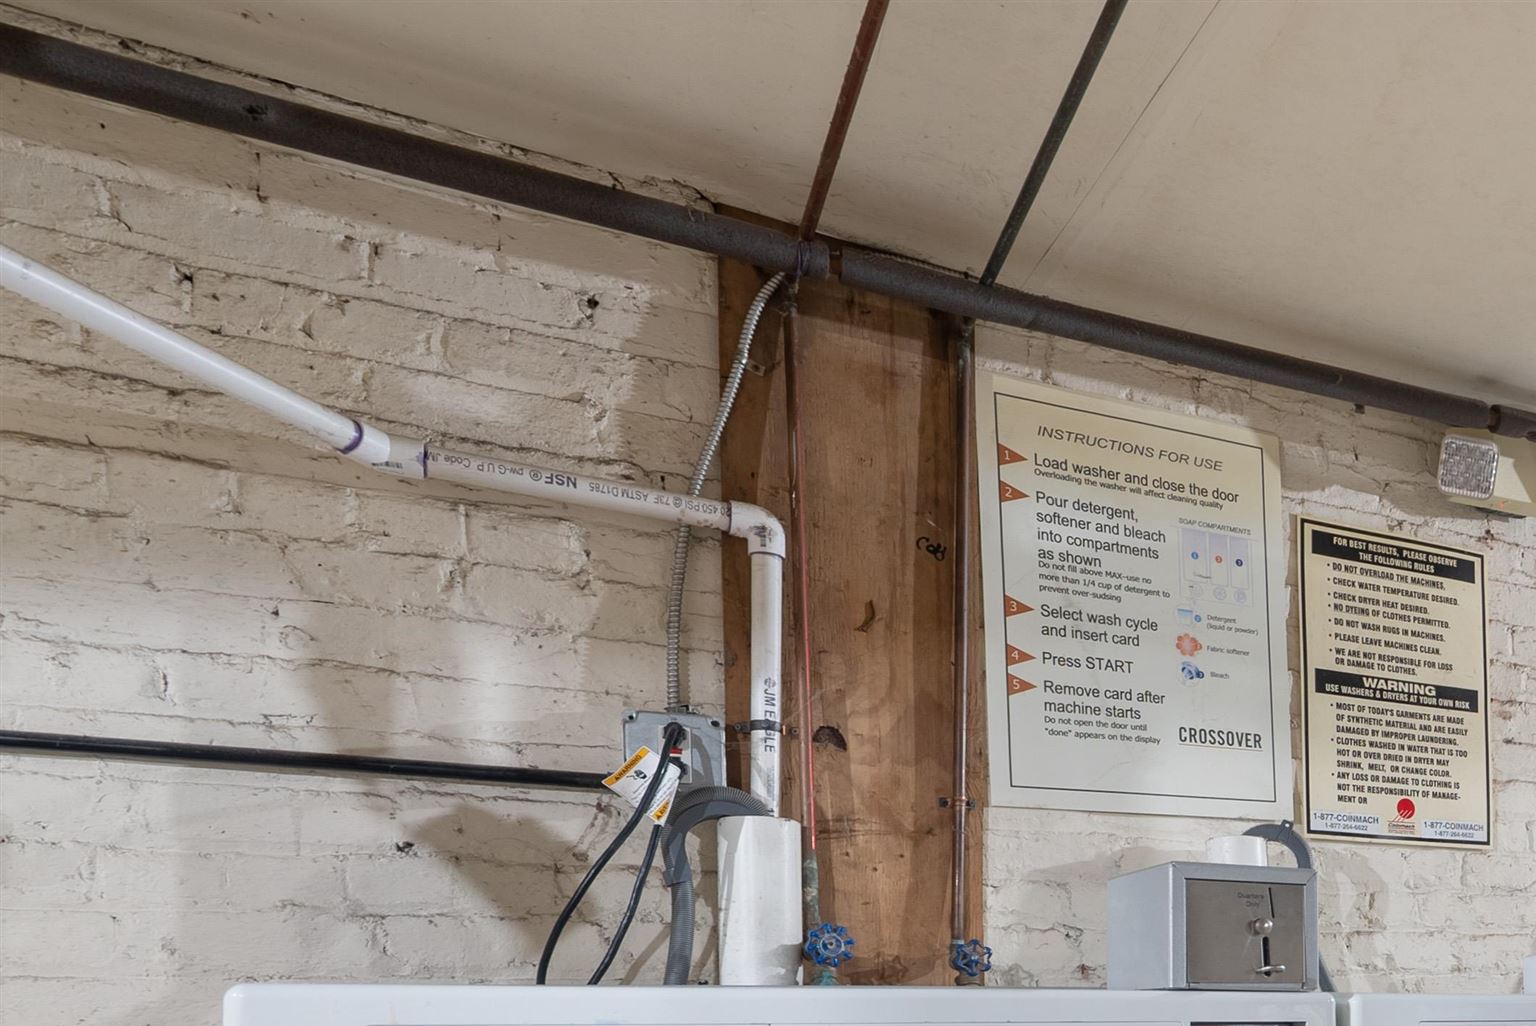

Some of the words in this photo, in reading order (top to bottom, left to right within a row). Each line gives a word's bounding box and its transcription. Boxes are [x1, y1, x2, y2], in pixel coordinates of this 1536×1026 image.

[1004, 449, 1011, 461] 1
[1037, 425, 1155, 458] INSTRUCTIONS
[1158, 449, 1190, 465] FOR
[1193, 456, 1223, 472] USE
[443, 454, 471, 468] Code
[545, 473, 577, 489] NSF
[1034, 452, 1068, 472] Load
[1071, 463, 1121, 481] washer
[1123, 473, 1148, 487] and
[1151, 476, 1185, 493] close
[1188, 482, 1208, 498] the
[1211, 487, 1239, 503] door
[589, 481, 620, 498] D1785
[621, 487, 648, 501] ASTM
[1004, 486, 1013, 498] 2
[684, 500, 700, 511] PSI
[1035, 490, 1069, 508] Pour
[1071, 497, 1138, 523] detergent,
[1035, 511, 1092, 530] softener
[1095, 522, 1119, 535] and
[1123, 523, 1166, 543] bleach
[1037, 527, 1062, 544] into
[1066, 535, 1159, 560] compartments
[1332, 536, 1348, 547] FOR
[1348, 539, 1367, 550] BEST
[1367, 542, 1399, 557] RESULTS,
[1402, 549, 1427, 562] PLEASE
[1428, 554, 1457, 568] OBSERVE
[1037, 548, 1054, 561] as
[1058, 550, 1102, 568] shown
[1358, 551, 1372, 562] THE
[1373, 554, 1412, 569] FOLLOWING
[1413, 561, 1435, 573] RULES
[1332, 561, 1342, 572] DO
[1343, 564, 1358, 575] NOT
[1359, 567, 1394, 581] OVERLOAD
[1395, 573, 1409, 584] THE
[1332, 576, 1356, 588] CHECK
[1357, 580, 1381, 592] WATER
[1382, 585, 1429, 601] TEMPERATURE
[1009, 600, 1017, 612] 3
[1332, 591, 1357, 603] CHECK
[1357, 595, 1380, 607] DRYER
[1381, 599, 1399, 609] HEAT
[1040, 603, 1084, 622] Select
[1086, 612, 1122, 627] wash
[1125, 617, 1158, 632] cycle
[1333, 602, 1344, 612] NO
[1344, 604, 1370, 617] DYEING
[1371, 608, 1380, 617] OF
[1382, 610, 1411, 623] CLOTHES
[1040, 624, 1067, 638] and
[1070, 625, 1109, 643] insert
[1111, 634, 1140, 647] card
[1333, 617, 1344, 626] DO
[1345, 619, 1359, 629] NOT
[1360, 621, 1381, 632] WASH
[1382, 624, 1400, 635] RUGS
[1401, 628, 1409, 636] IN
[1334, 632, 1360, 644] PLEASE
[1361, 636, 1382, 647] LEAVE
[1383, 639, 1418, 652] MACHINES
[1011, 650, 1019, 661] 4
[1042, 651, 1082, 668] Press
[1085, 655, 1134, 674] START
[1012, 678, 1020, 690] 5
[1043, 679, 1100, 698] Remove
[1103, 688, 1132, 701] card
[1136, 689, 1166, 704] after
[1362, 676, 1436, 696] WARNING
[764, 689, 776, 707] JM
[1325, 683, 1339, 693] USE
[1340, 685, 1374, 698] WASHERS
[1375, 689, 1381, 698] &
[1382, 690, 1409, 702] DRYERS
[1409, 694, 1418, 703] AT
[1418, 695, 1437, 706] YOUR
[1437, 697, 1454, 708] OWN
[1454, 699, 1470, 710] RISK
[1043, 701, 1101, 716] machine
[1105, 705, 1141, 720] starts
[764, 709, 776, 753] EGLE
[1178, 726, 1262, 749] CROSSOVER
[1313, 812, 1379, 824] 1-877-COINMACH
[1423, 820, 1484, 832] 1-877-COINMACH
